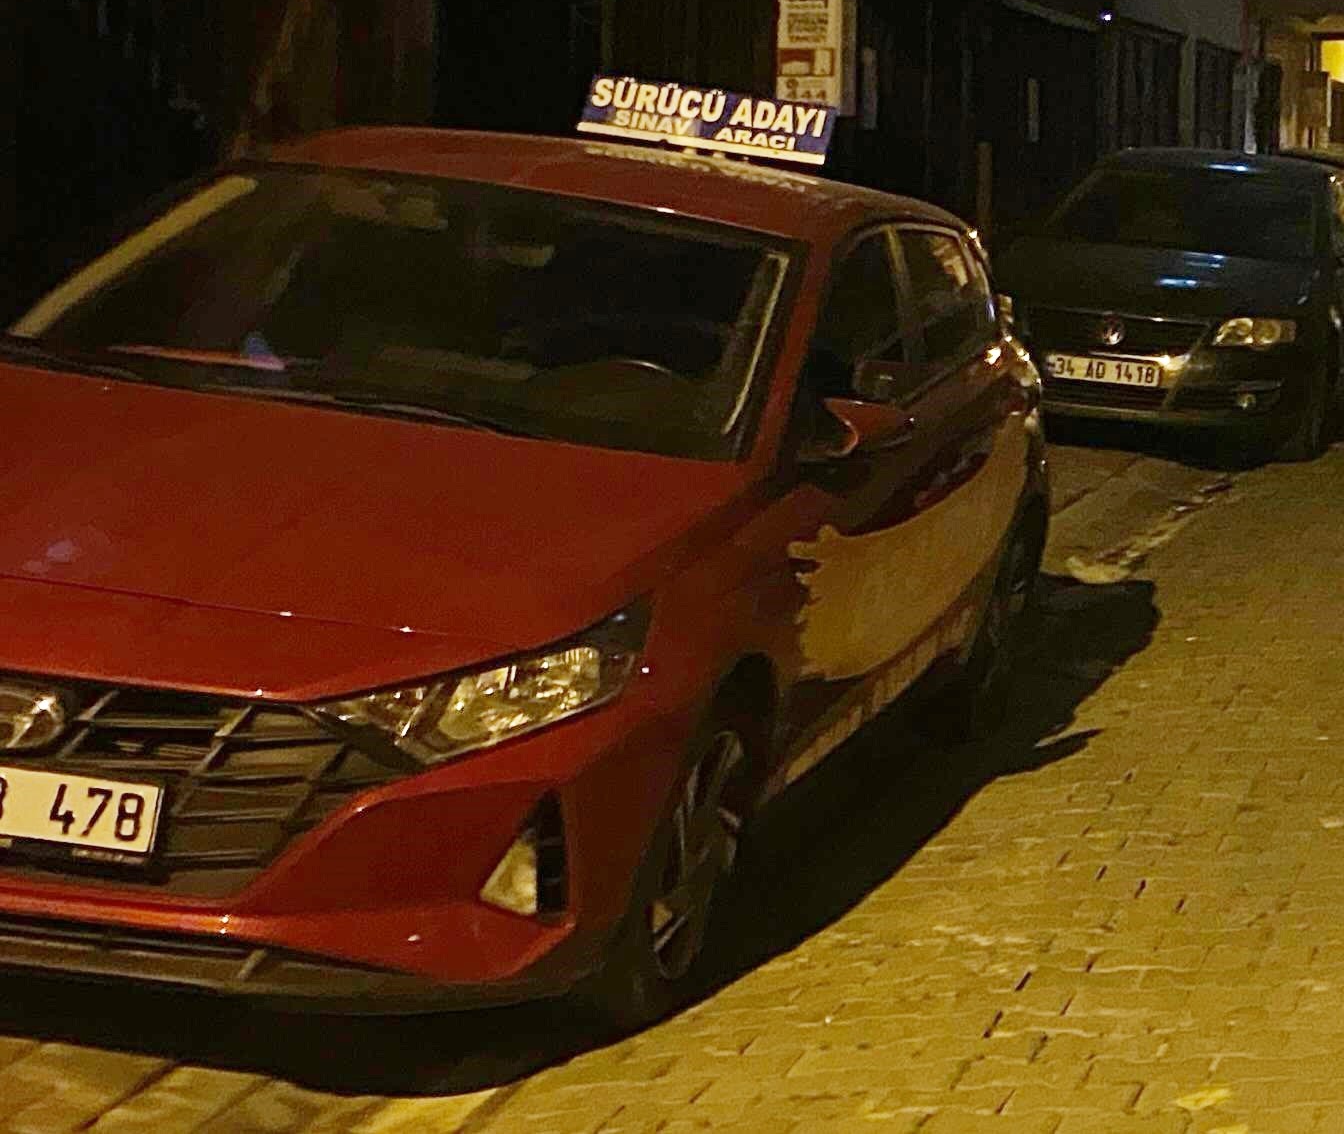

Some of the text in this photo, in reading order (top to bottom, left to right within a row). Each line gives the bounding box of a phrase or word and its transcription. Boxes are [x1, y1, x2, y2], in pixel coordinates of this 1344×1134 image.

[592, 77, 827, 137] SÜRÜCÜ ADAYI
[615, 110, 796, 151] SINAV ARACI
[1056, 357, 1074, 377] 34
[49, 783, 146, 842] 478
